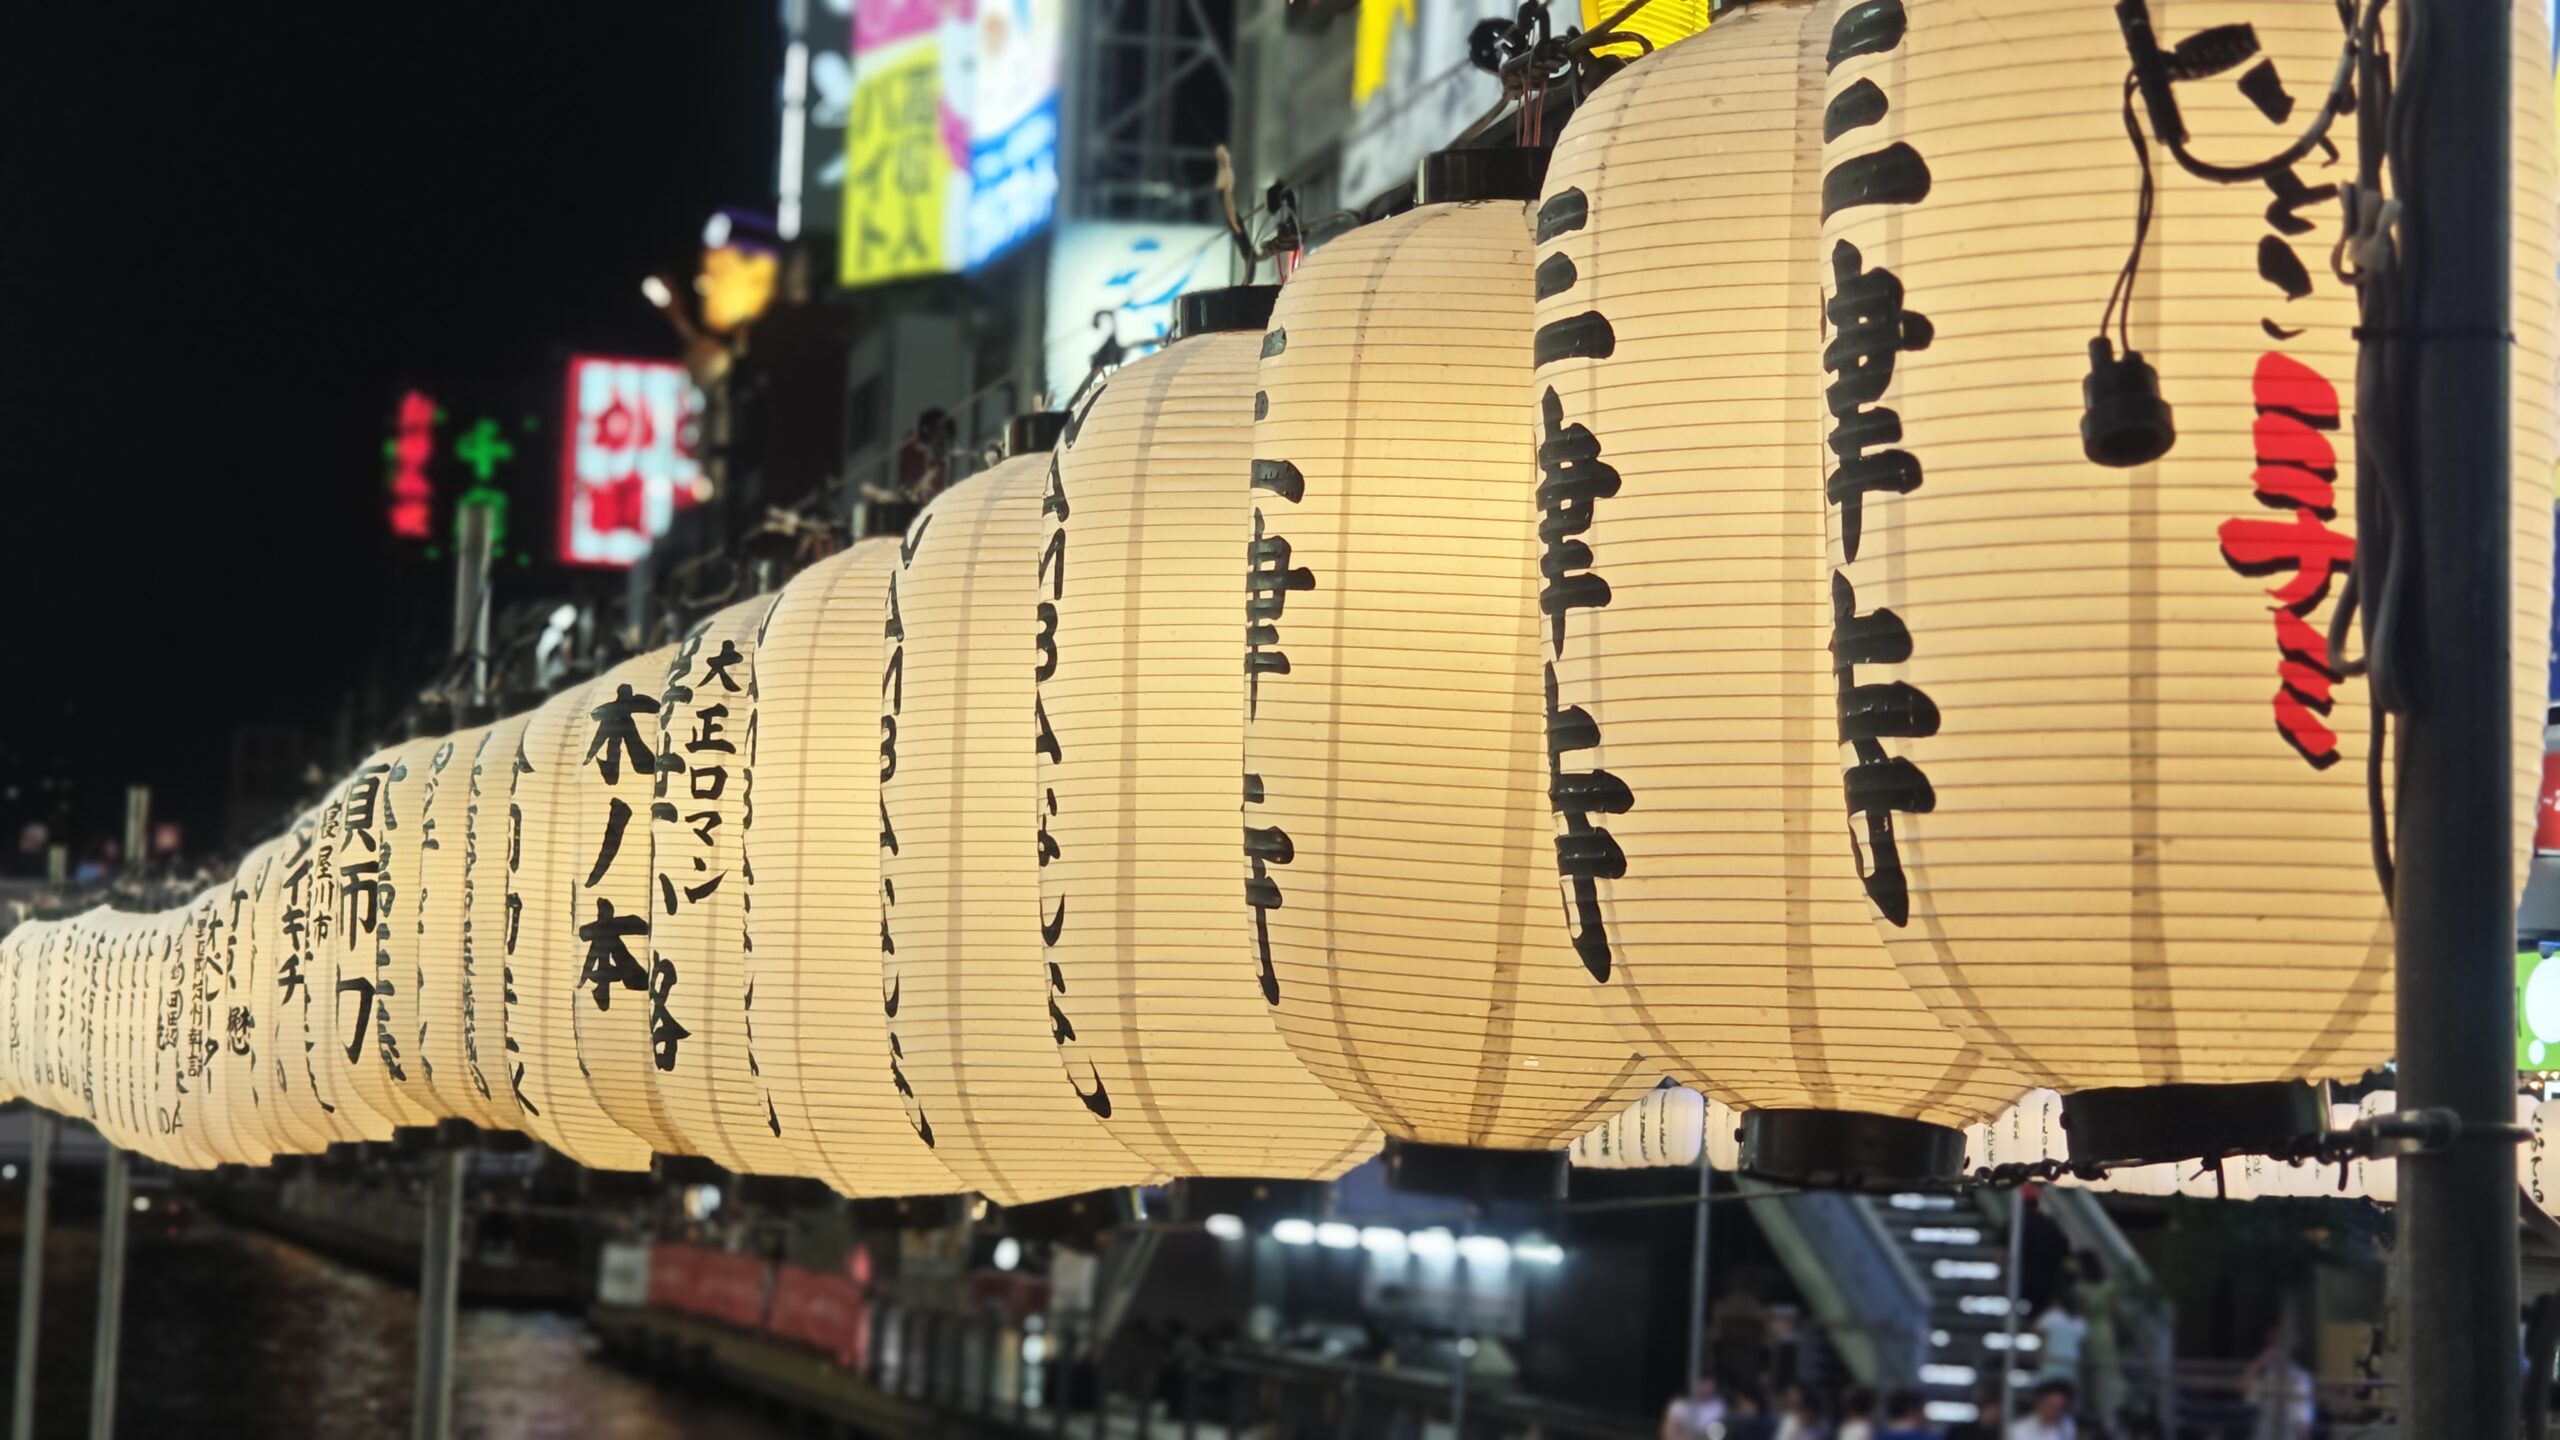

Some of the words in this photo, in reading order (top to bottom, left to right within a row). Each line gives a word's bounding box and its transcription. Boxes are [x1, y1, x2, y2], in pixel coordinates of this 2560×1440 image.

[577, 684, 661, 1011] 木ノ本
[685, 639, 743, 904] 大正ロマン
